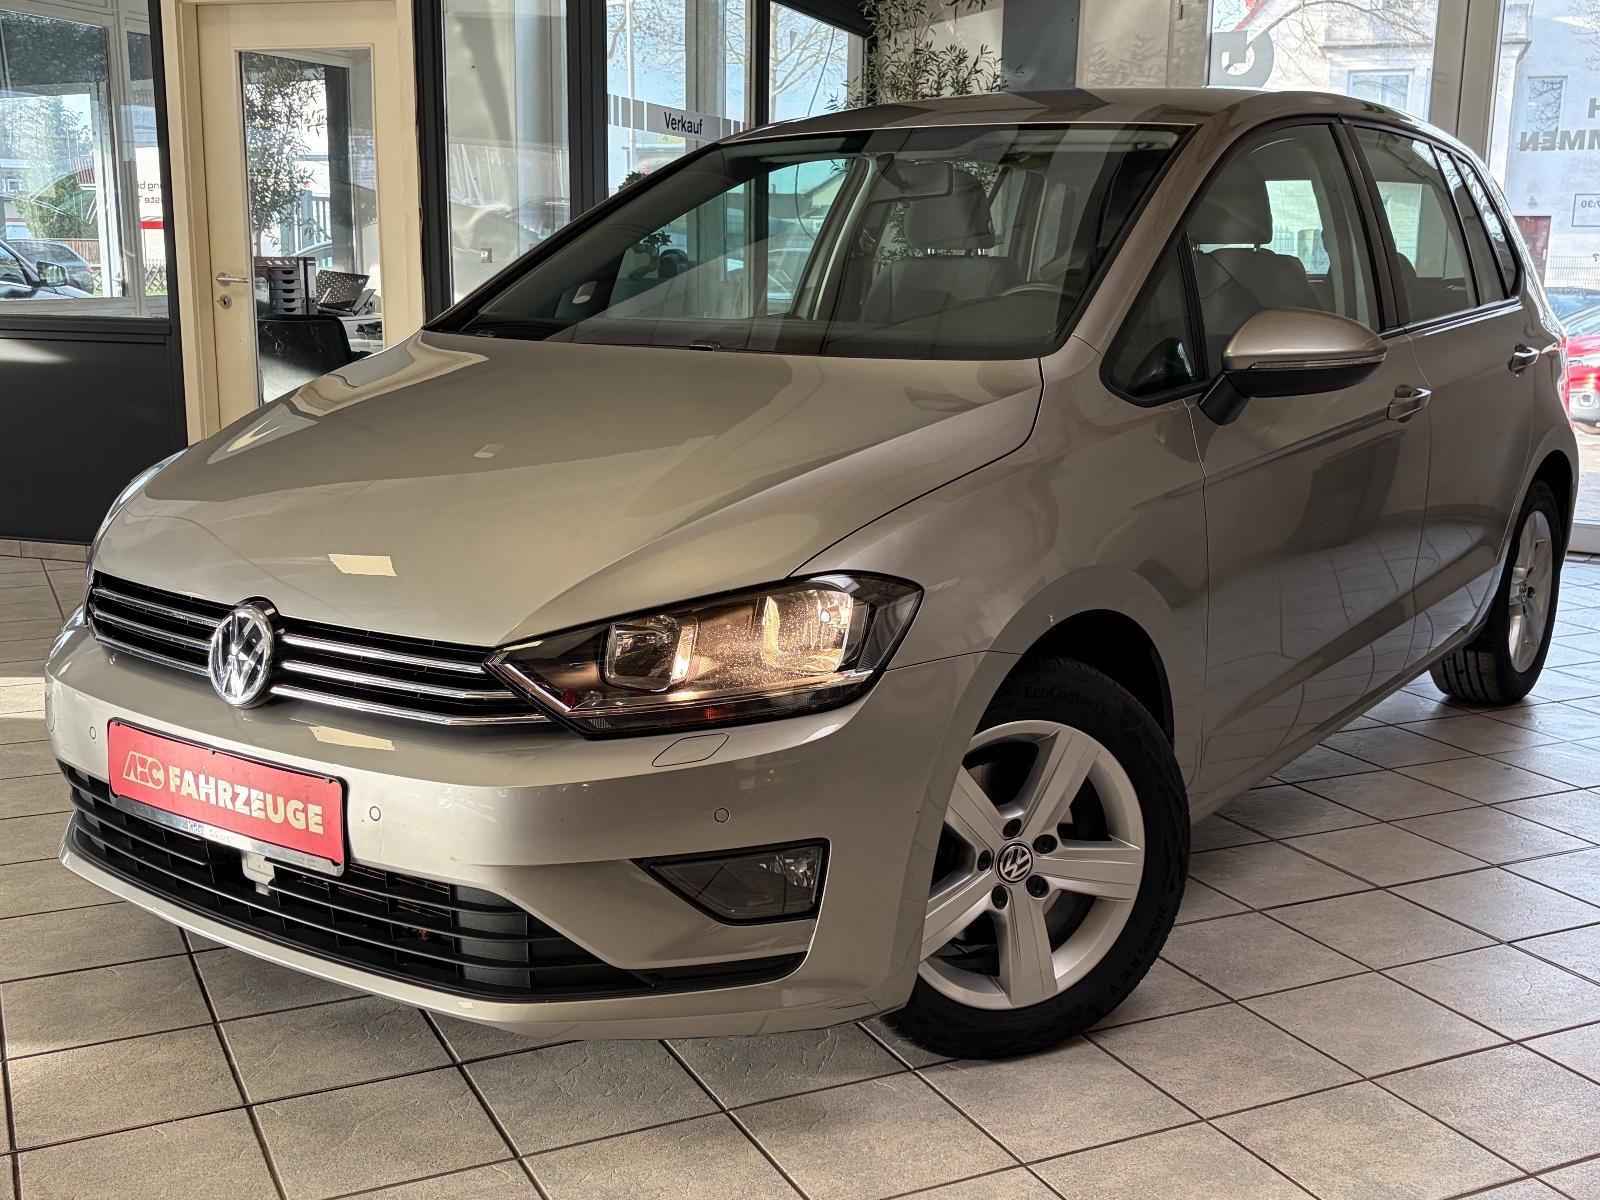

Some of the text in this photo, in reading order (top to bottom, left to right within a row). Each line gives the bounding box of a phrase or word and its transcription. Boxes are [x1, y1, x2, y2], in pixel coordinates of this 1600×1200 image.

[664, 112, 703, 135] Verkauf
[209, 605, 272, 705] VW
[168, 765, 324, 834] FAHRZEUGE
[997, 844, 1032, 882] VW
